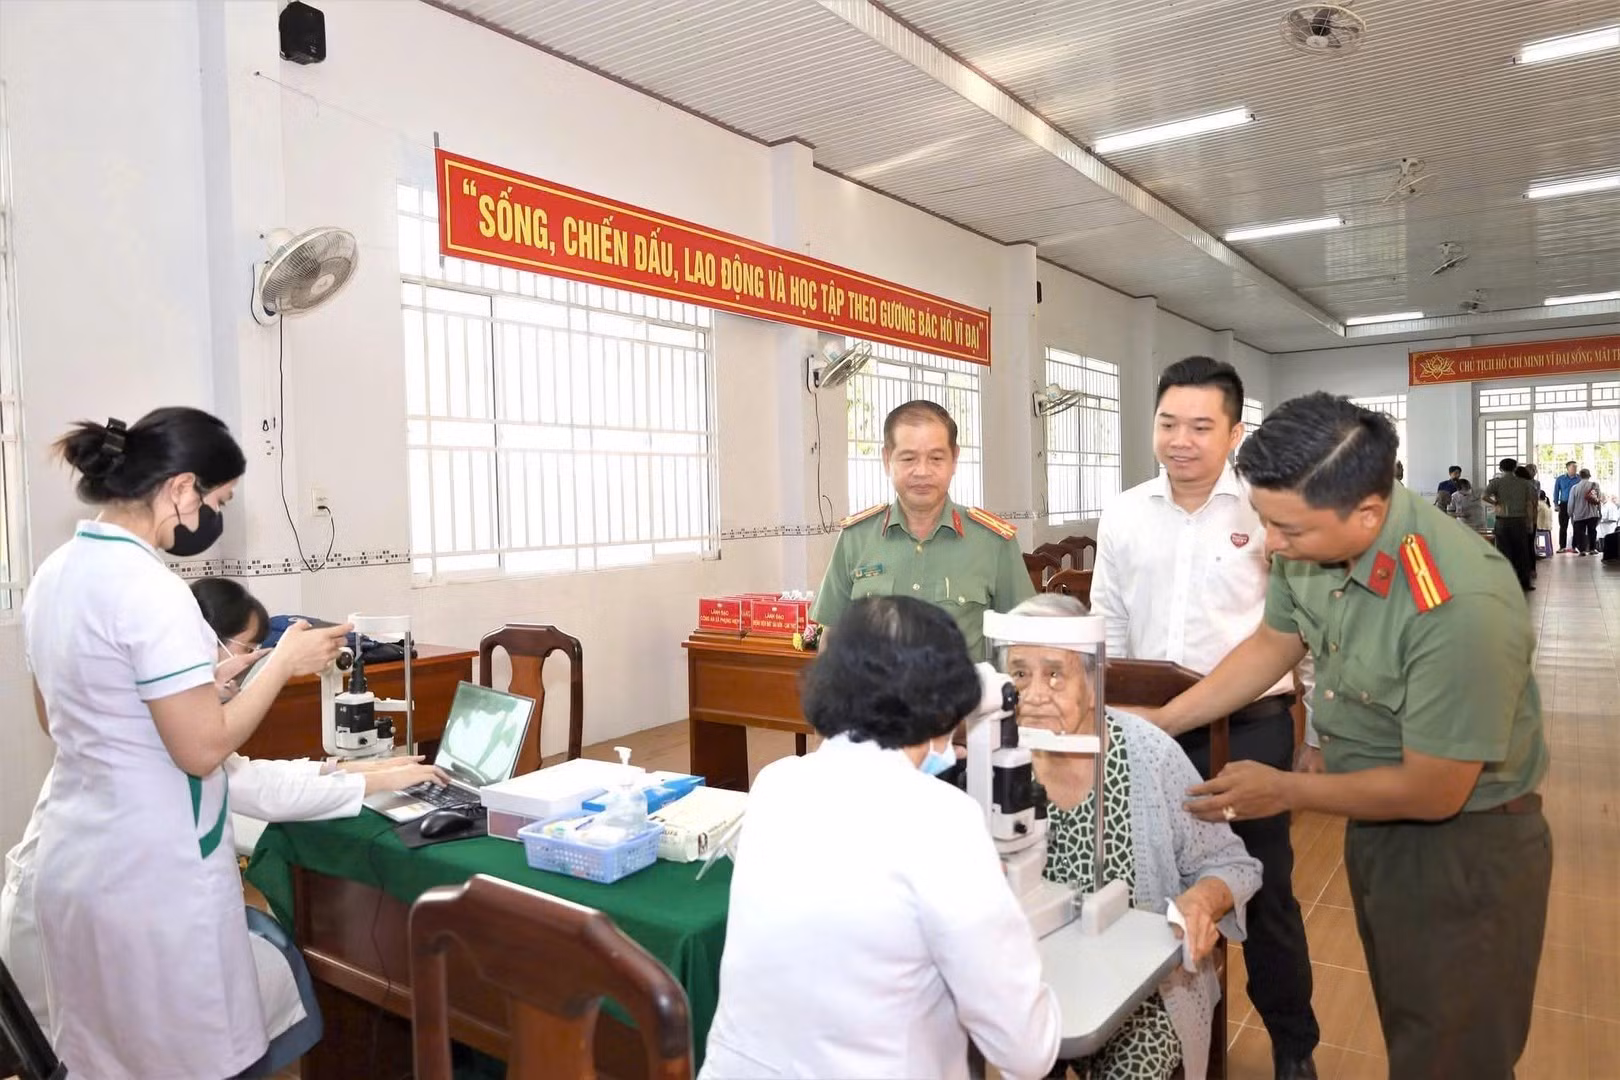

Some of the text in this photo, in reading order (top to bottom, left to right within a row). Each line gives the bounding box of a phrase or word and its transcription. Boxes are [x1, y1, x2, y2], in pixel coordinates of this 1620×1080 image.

[462, 178, 556, 257] “SỐNG,
[563, 215, 629, 268] CHIẾN
[634, 227, 679, 284] ĐẤU,
[684, 247, 716, 288] LAO
[720, 253, 765, 301] ĐỘNG
[768, 265, 787, 304] VÀ
[790, 275, 817, 315] HỌC
[821, 280, 845, 321] TẬP
[848, 290, 877, 325] THEO
[880, 300, 916, 334] GƯƠNG
[918, 307, 938, 339] BÁC
[940, 309, 952, 343] HỒ
[954, 318, 964, 346] VĨ
[1459, 356, 1474, 373] CHỦ
[1477, 358, 1494, 374] TỊCH
[1508, 354, 1522, 368] CHÍ
[1523, 354, 1544, 368] MINH
[1570, 346, 1593, 364] SỐNG
